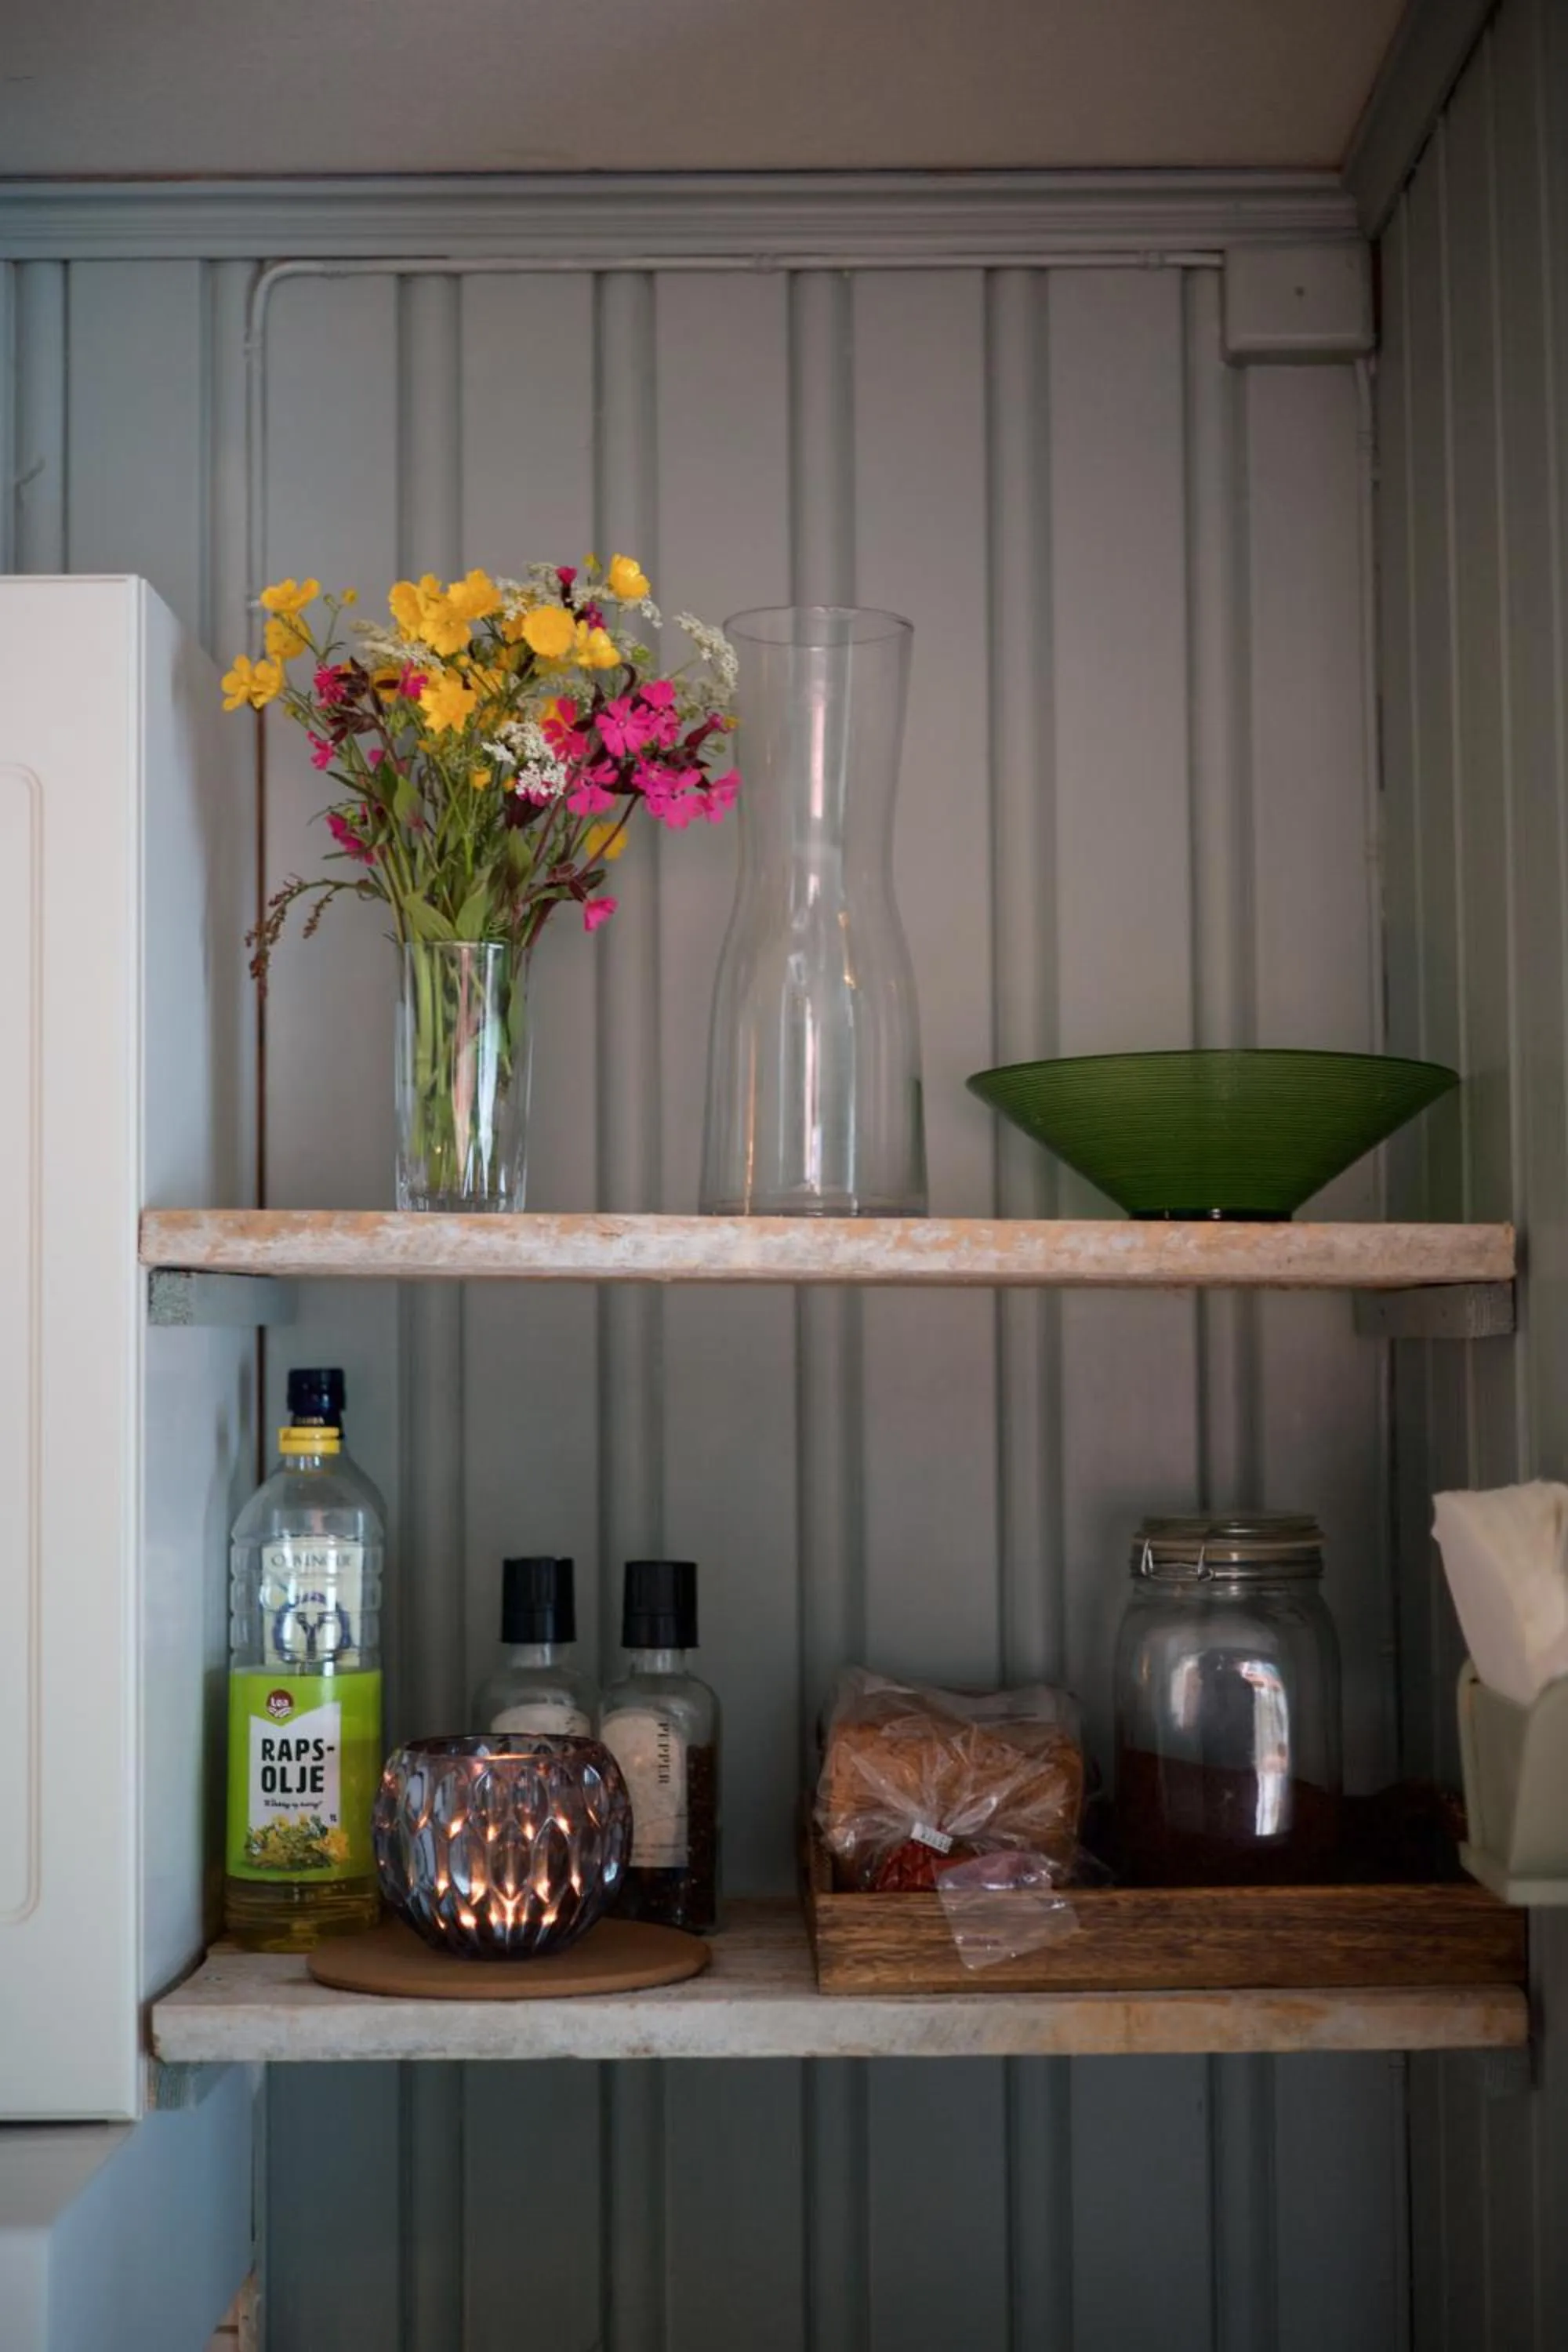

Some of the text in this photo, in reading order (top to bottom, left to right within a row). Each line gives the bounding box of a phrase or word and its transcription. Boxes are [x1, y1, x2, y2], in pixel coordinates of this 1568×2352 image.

[261, 1738, 335, 1762] RAPS-
[657, 1722, 670, 1784] PEPPER
[261, 1766, 325, 1793] OLJE
